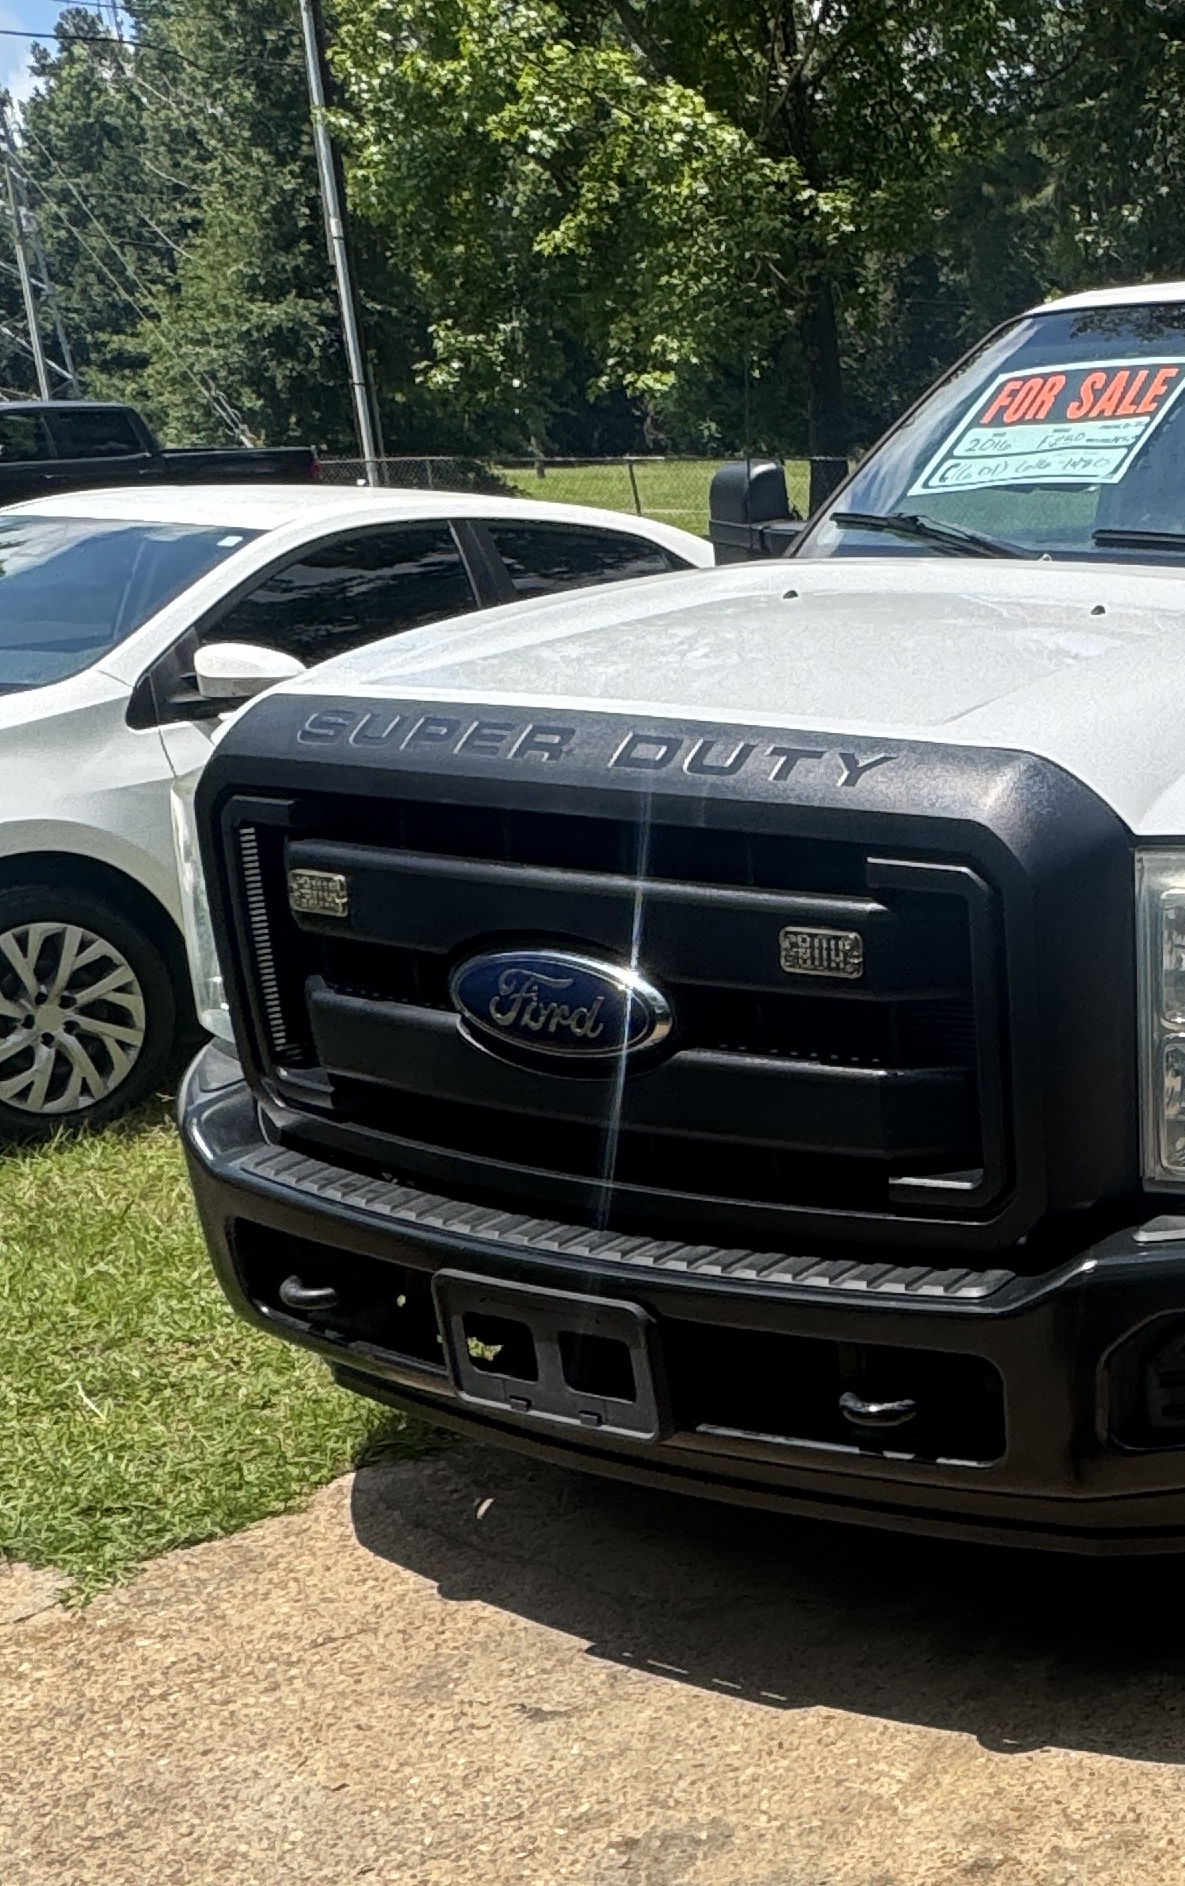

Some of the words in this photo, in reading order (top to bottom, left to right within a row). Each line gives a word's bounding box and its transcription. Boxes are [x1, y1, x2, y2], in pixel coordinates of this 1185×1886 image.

[979, 374, 1067, 425] FOR
[1066, 366, 1180, 420] SALE
[297, 708, 577, 763] SUPER
[606, 730, 898, 789] DUTY
[488, 967, 606, 1040] Ford
